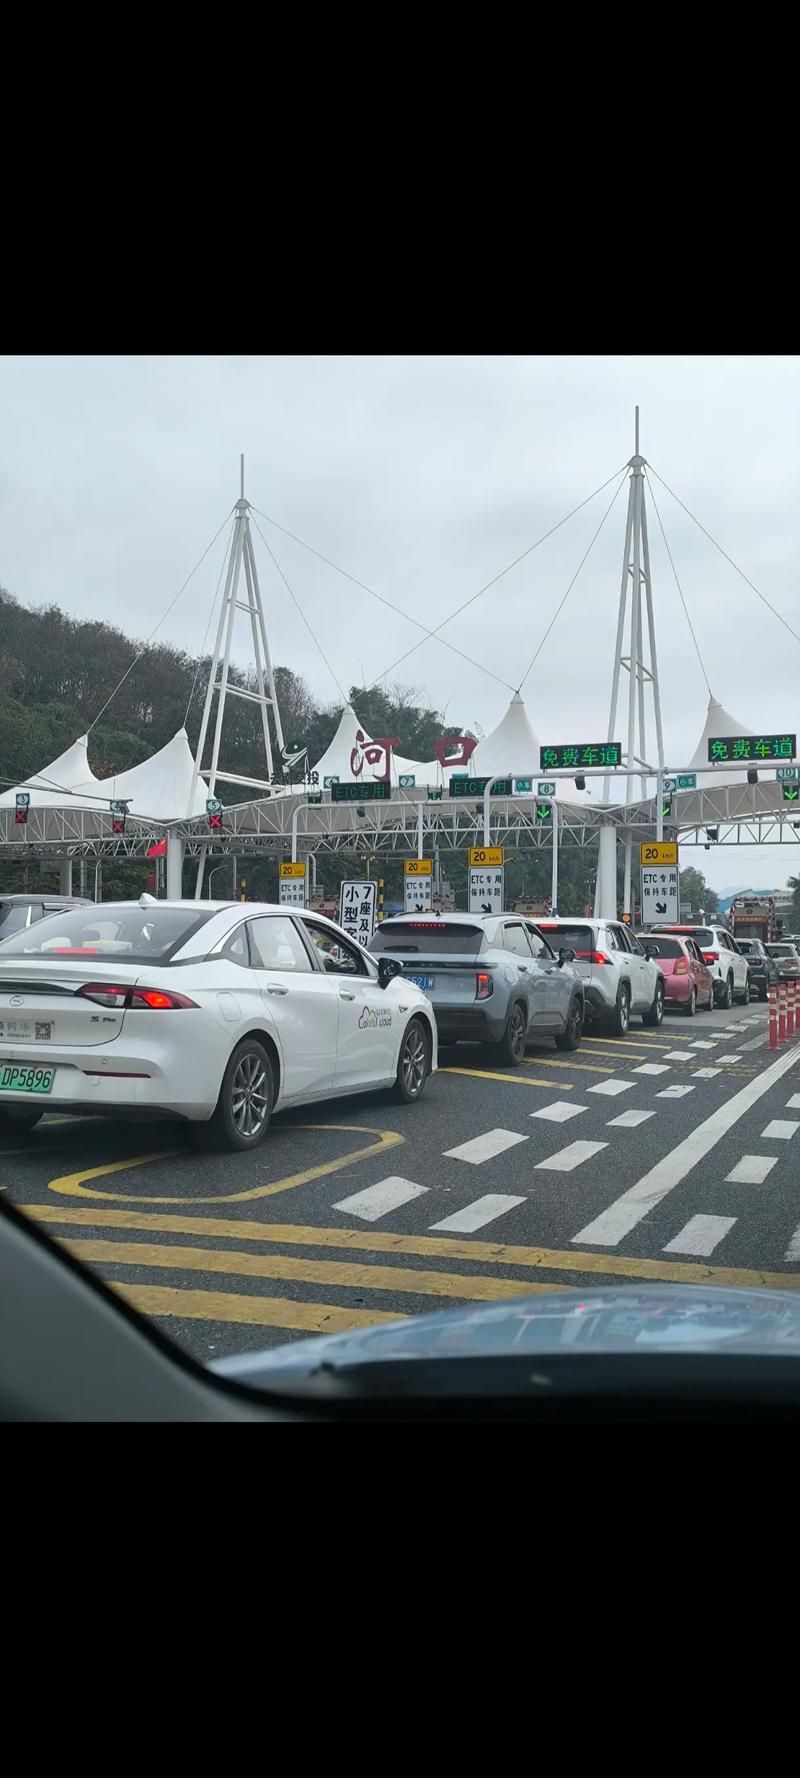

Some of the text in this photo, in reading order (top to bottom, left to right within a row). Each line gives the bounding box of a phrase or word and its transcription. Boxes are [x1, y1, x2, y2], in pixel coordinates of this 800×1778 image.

[711, 738, 793, 759] 免费车道
[351, 730, 479, 783] 河口
[543, 746, 619, 767] 免费车道
[336, 784, 385, 799] ETC专用
[473, 851, 486, 861] 20
[645, 848, 659, 859] 20
[283, 867, 293, 875] 20
[408, 863, 418, 871] 20
[643, 874, 677, 883] ETC专用
[471, 888, 501, 897] 保持车距
[644, 887, 677, 896] 保持车距
[1, 1067, 52, 1089] DP5896
